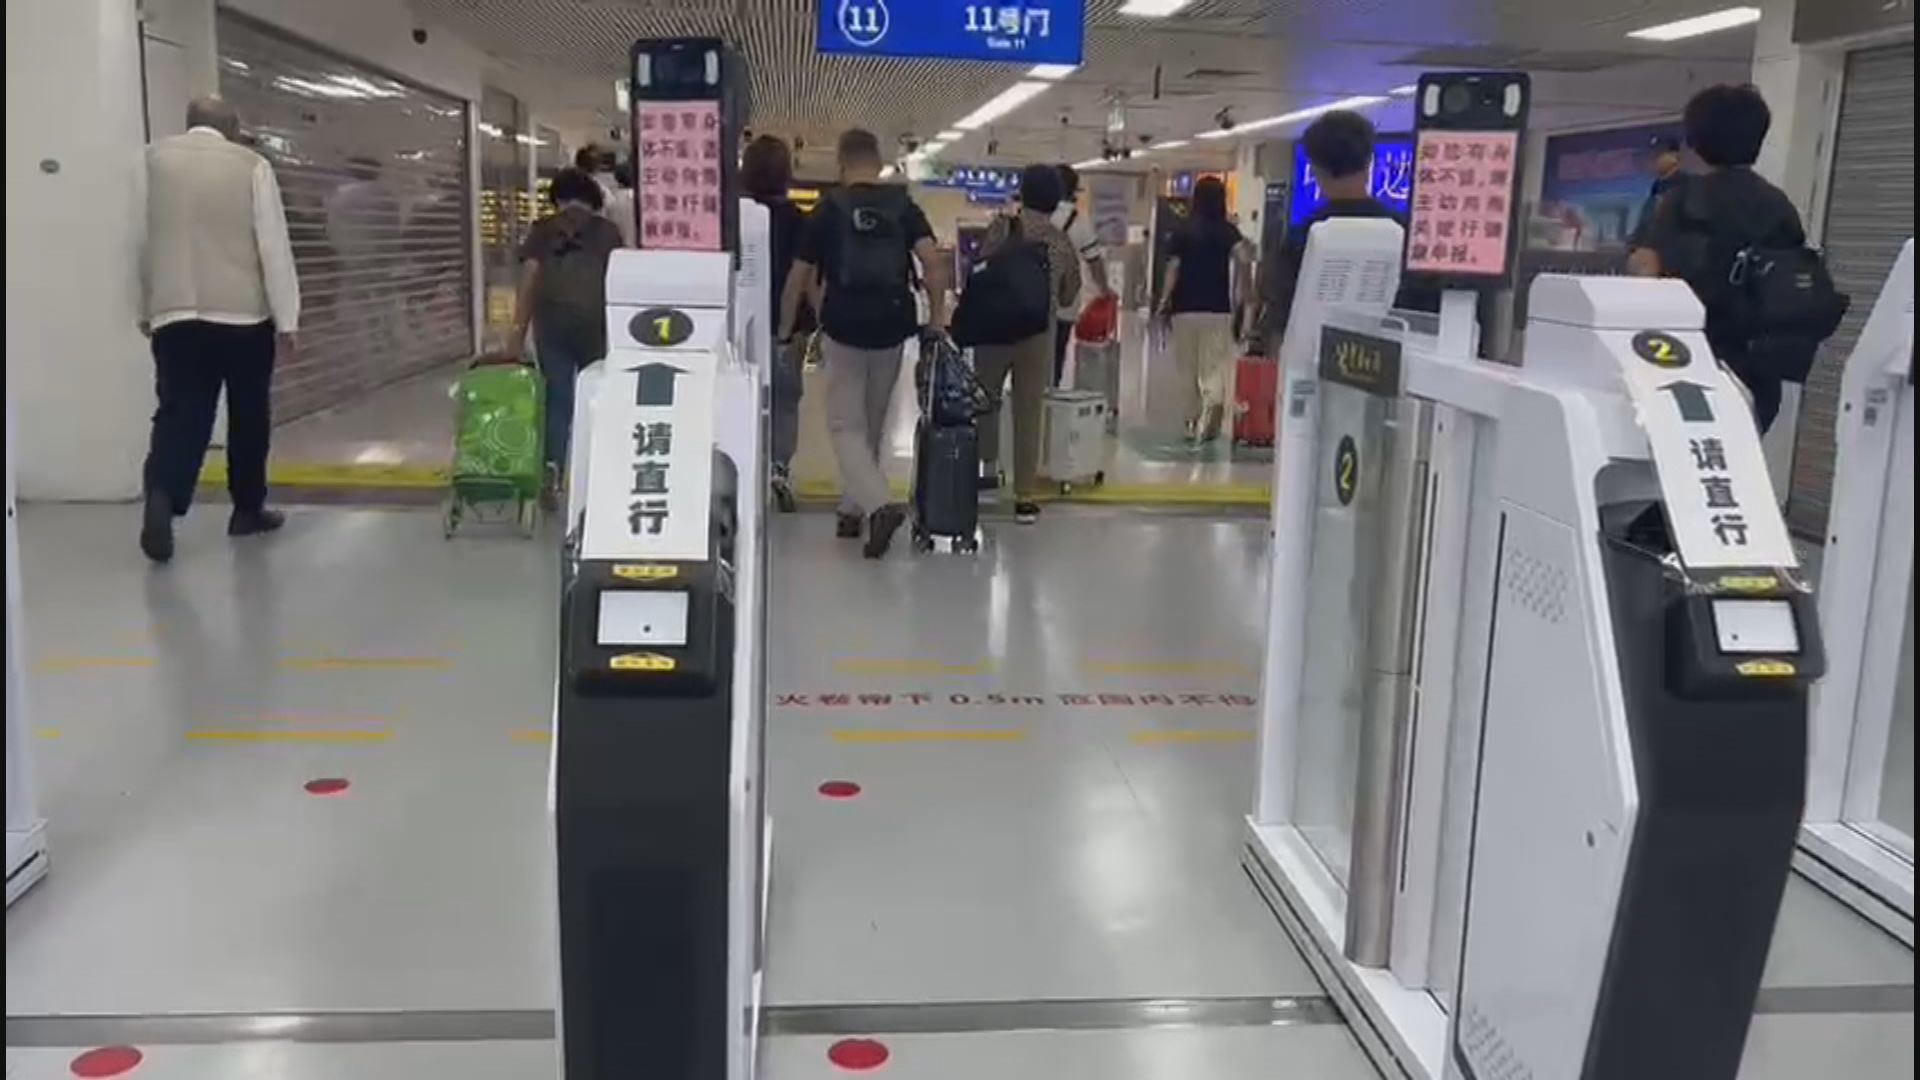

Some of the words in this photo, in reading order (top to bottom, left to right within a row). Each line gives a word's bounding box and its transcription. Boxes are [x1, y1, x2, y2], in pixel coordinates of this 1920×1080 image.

[848, 6, 880, 33] 11
[964, 5, 1051, 37] 11号门
[653, 316, 671, 344] 1
[1646, 339, 1678, 364] 2
[627, 421, 673, 536] 请直行
[1339, 452, 1353, 490] 2
[1688, 437, 1750, 547] 请直行
[949, 694, 1045, 706] 0.5m
